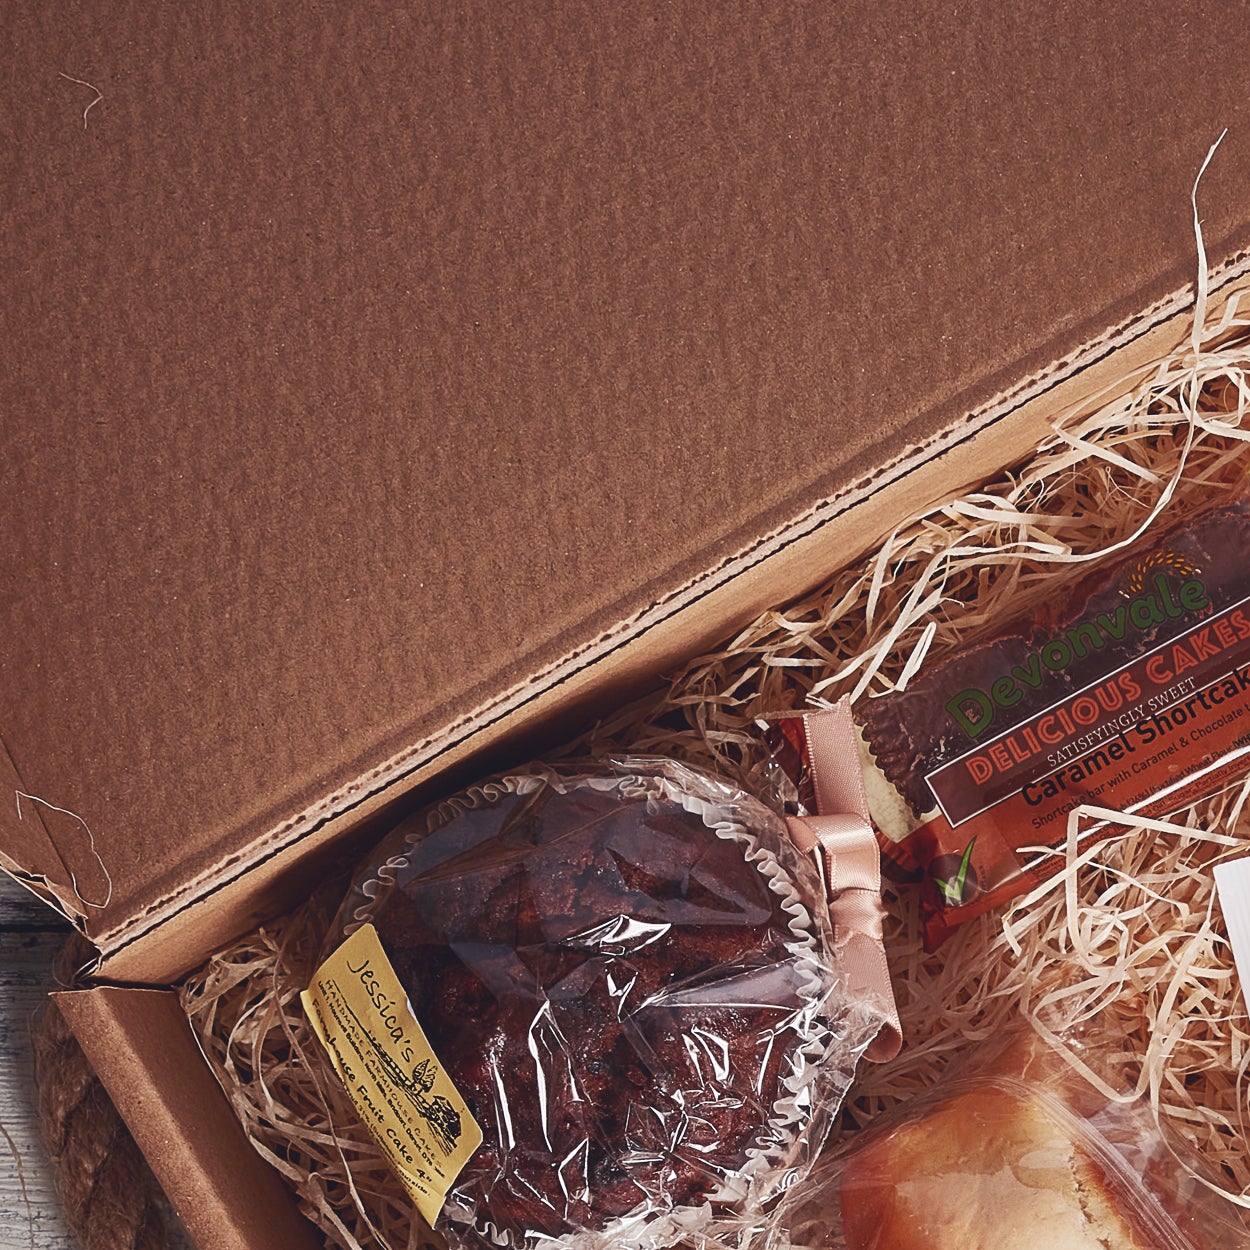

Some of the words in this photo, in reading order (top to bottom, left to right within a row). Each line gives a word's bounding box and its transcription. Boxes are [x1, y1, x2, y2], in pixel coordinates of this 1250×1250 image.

[943, 573, 1210, 738] Devonvale
[964, 670, 1144, 785] DELICIOUS
[1019, 730, 1137, 808] Caramel
[1031, 792, 1086, 830] Shortcake
[1085, 779, 1112, 800] bar
[1109, 766, 1131, 786] with
[1128, 739, 1180, 775] Caramel
[1178, 734, 1191, 748] &
[1188, 704, 1244, 742] Chocolate
[1046, 703, 1145, 767] SATISFYINGLY
[1146, 675, 1197, 711] SWEET
[347, 960, 414, 1063] Jessica's
[311, 999, 357, 1082] Farmhouse
[355, 1084, 386, 1123] Fruit
[384, 1126, 414, 1164] Cake
[325, 979, 364, 1046] HANDMADE
[365, 1049, 414, 1124] FARMHOUSE
[414, 1127, 442, 1168] CAKES
[364, 1062, 378, 1081] North
